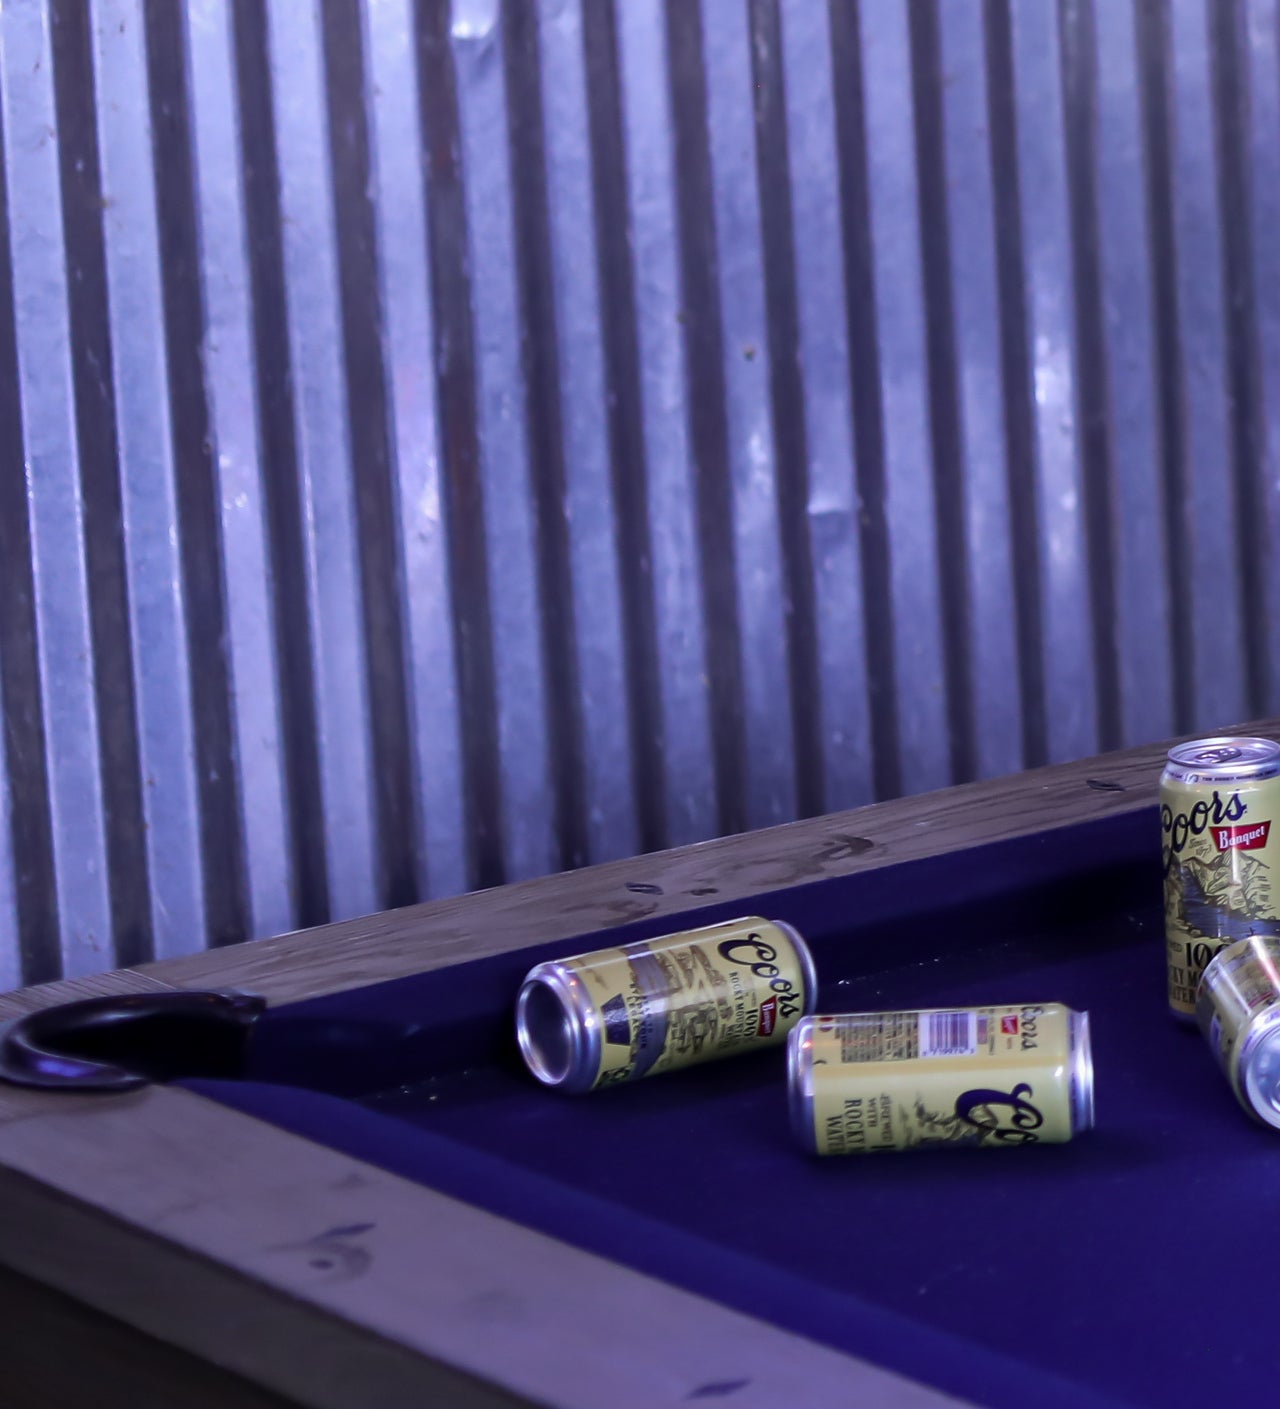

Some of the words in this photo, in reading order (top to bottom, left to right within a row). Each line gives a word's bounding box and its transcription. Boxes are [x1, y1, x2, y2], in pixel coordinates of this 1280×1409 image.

[1218, 824, 1267, 849] Banquet
[718, 932, 801, 1019] Coors
[844, 1098, 864, 1144] ROCKY
